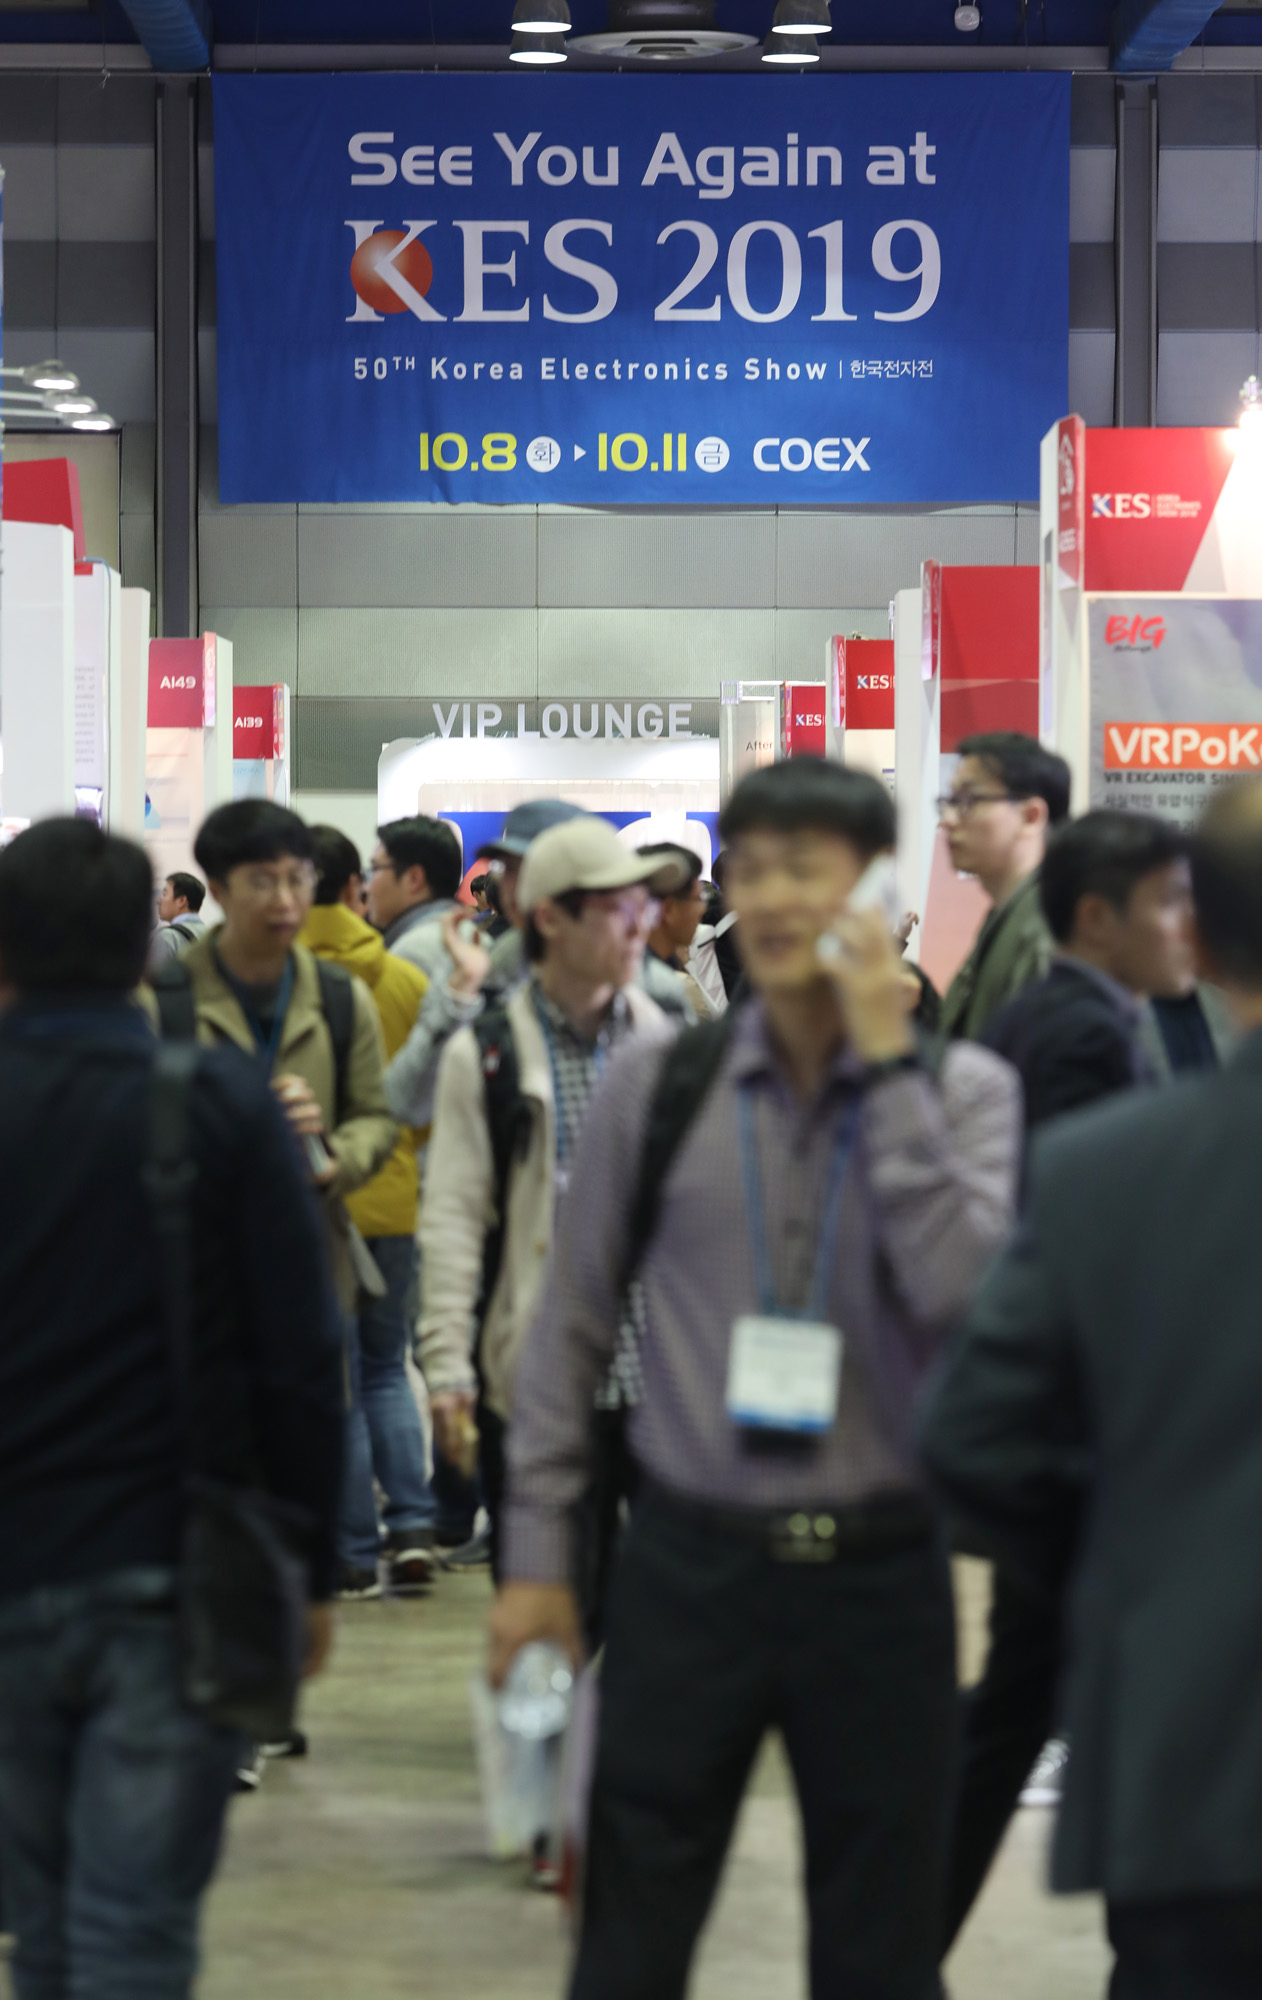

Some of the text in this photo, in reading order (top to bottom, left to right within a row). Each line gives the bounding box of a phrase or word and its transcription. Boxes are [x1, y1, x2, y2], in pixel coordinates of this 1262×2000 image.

[347, 131, 937, 199] See You Again at
[344, 218, 942, 324] KES 2019
[431, 356, 524, 381] Korea
[541, 356, 729, 381] Electronics
[744, 356, 828, 381] Show
[849, 359, 934, 379] 한국전자전
[752, 437, 872, 472] COEX
[1091, 493, 1151, 518] KES
[1104, 614, 1166, 649] BIG
[856, 674, 890, 690] KES
[432, 703, 692, 738] VIP LOUNGE
[795, 714, 823, 727] KES
[746, 741, 773, 751] After
[1126, 772, 1206, 785] EXCAVATOR
